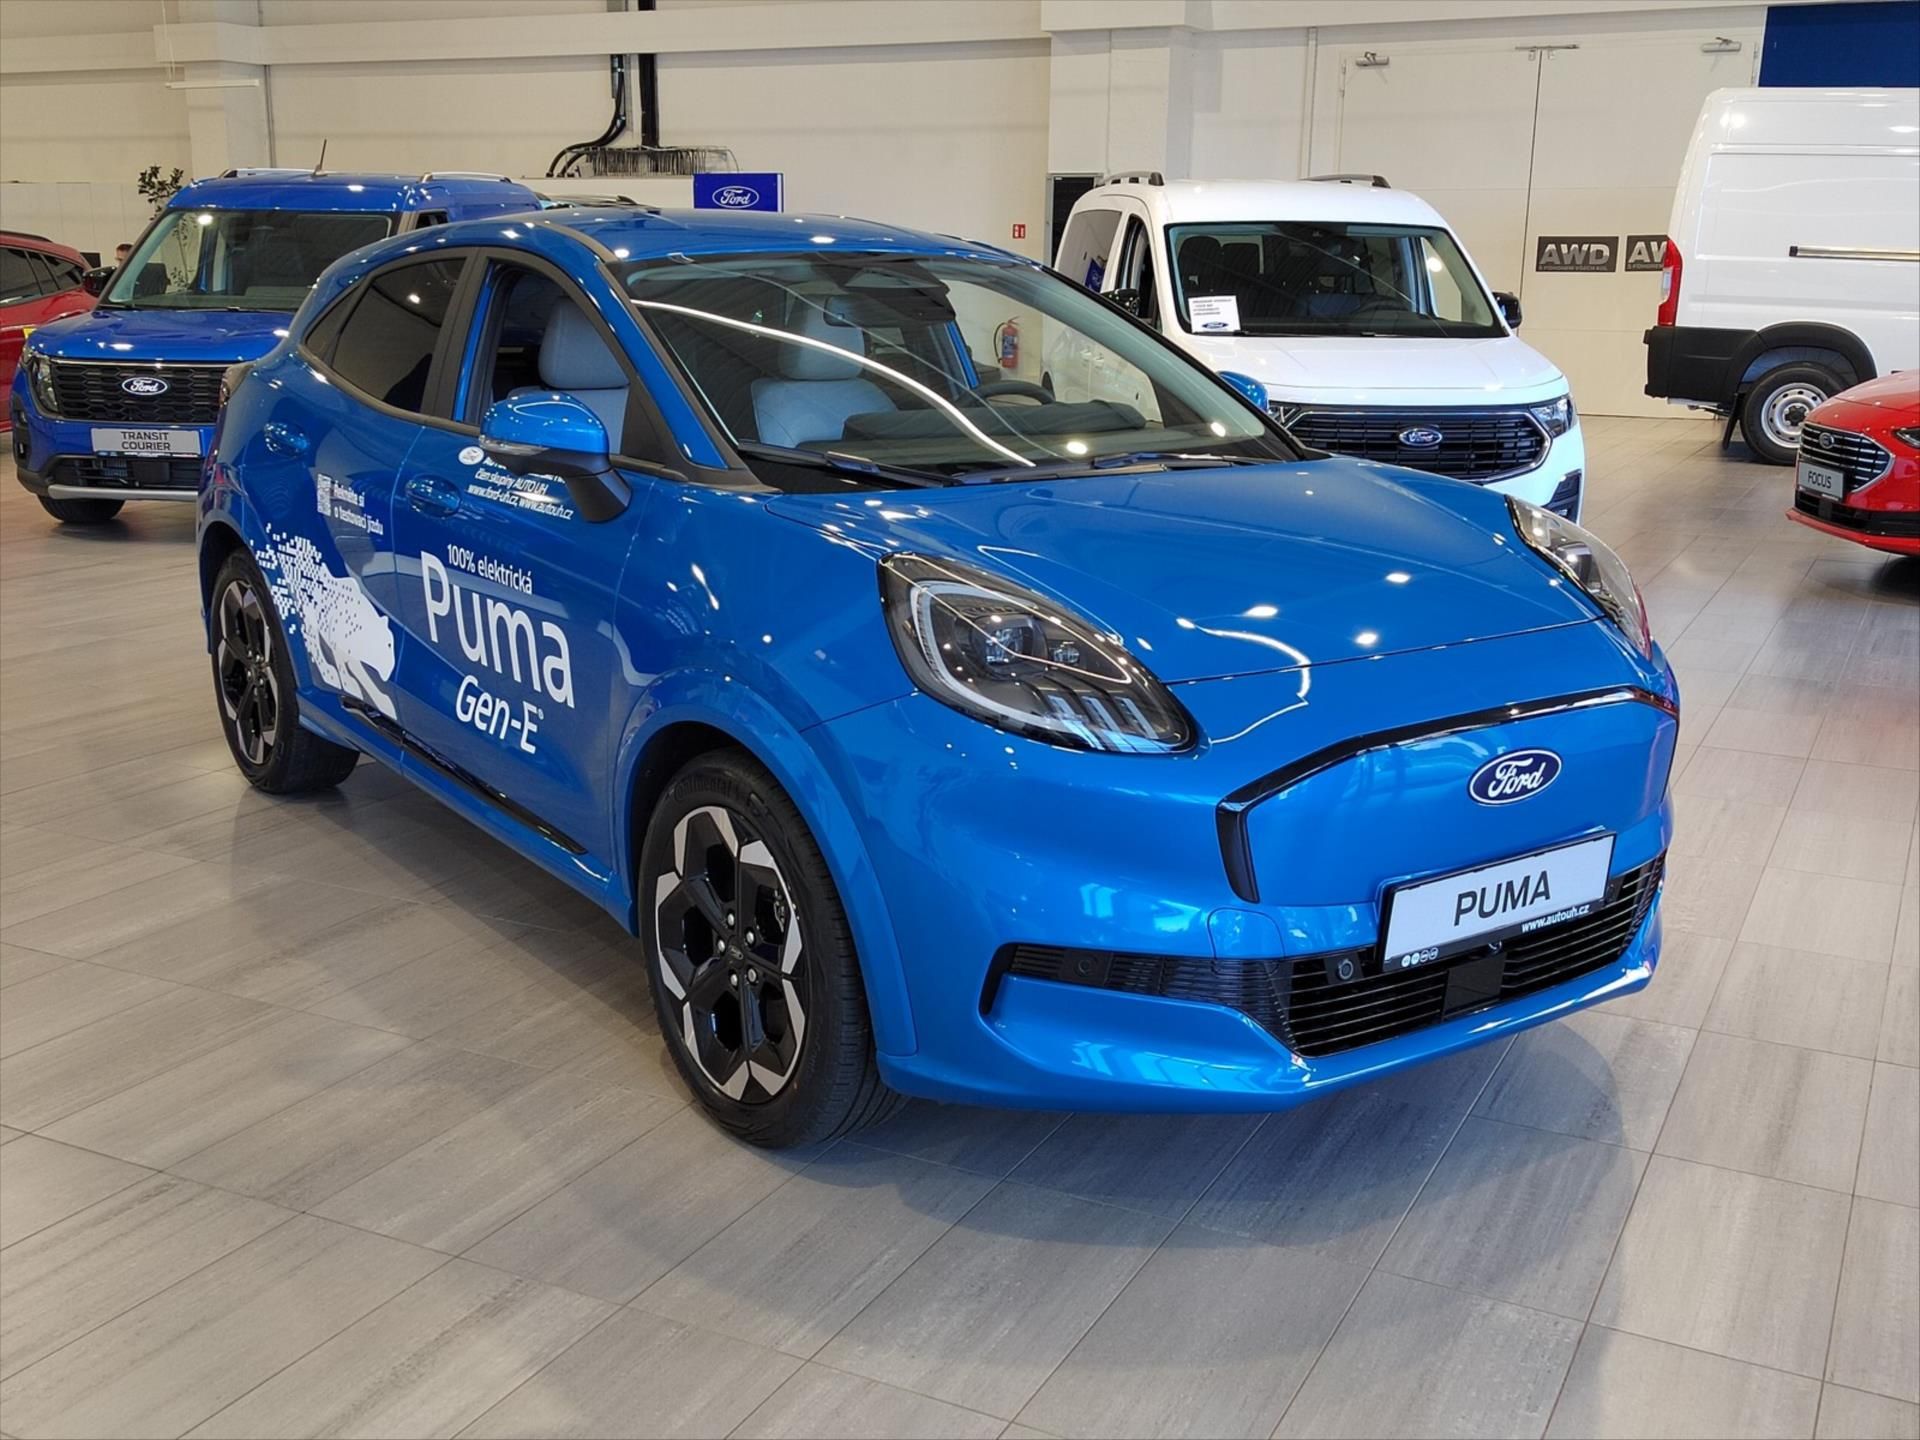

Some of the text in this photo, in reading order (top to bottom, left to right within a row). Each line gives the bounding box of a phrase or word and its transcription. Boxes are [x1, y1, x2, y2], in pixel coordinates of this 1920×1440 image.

[719, 188, 752, 205] Ford
[1539, 243, 1610, 265] AWD
[129, 379, 160, 393] Ford
[120, 431, 169, 441] TRANSIT
[121, 441, 171, 451] COURIER
[1808, 470, 1832, 489] FOCUS
[447, 544, 533, 595] 100% elektrická
[421, 551, 575, 709] Puma
[1487, 755, 1548, 799] Ford
[1454, 870, 1551, 927] PUMA
[1521, 904, 1590, 933] www.autouh.cz
